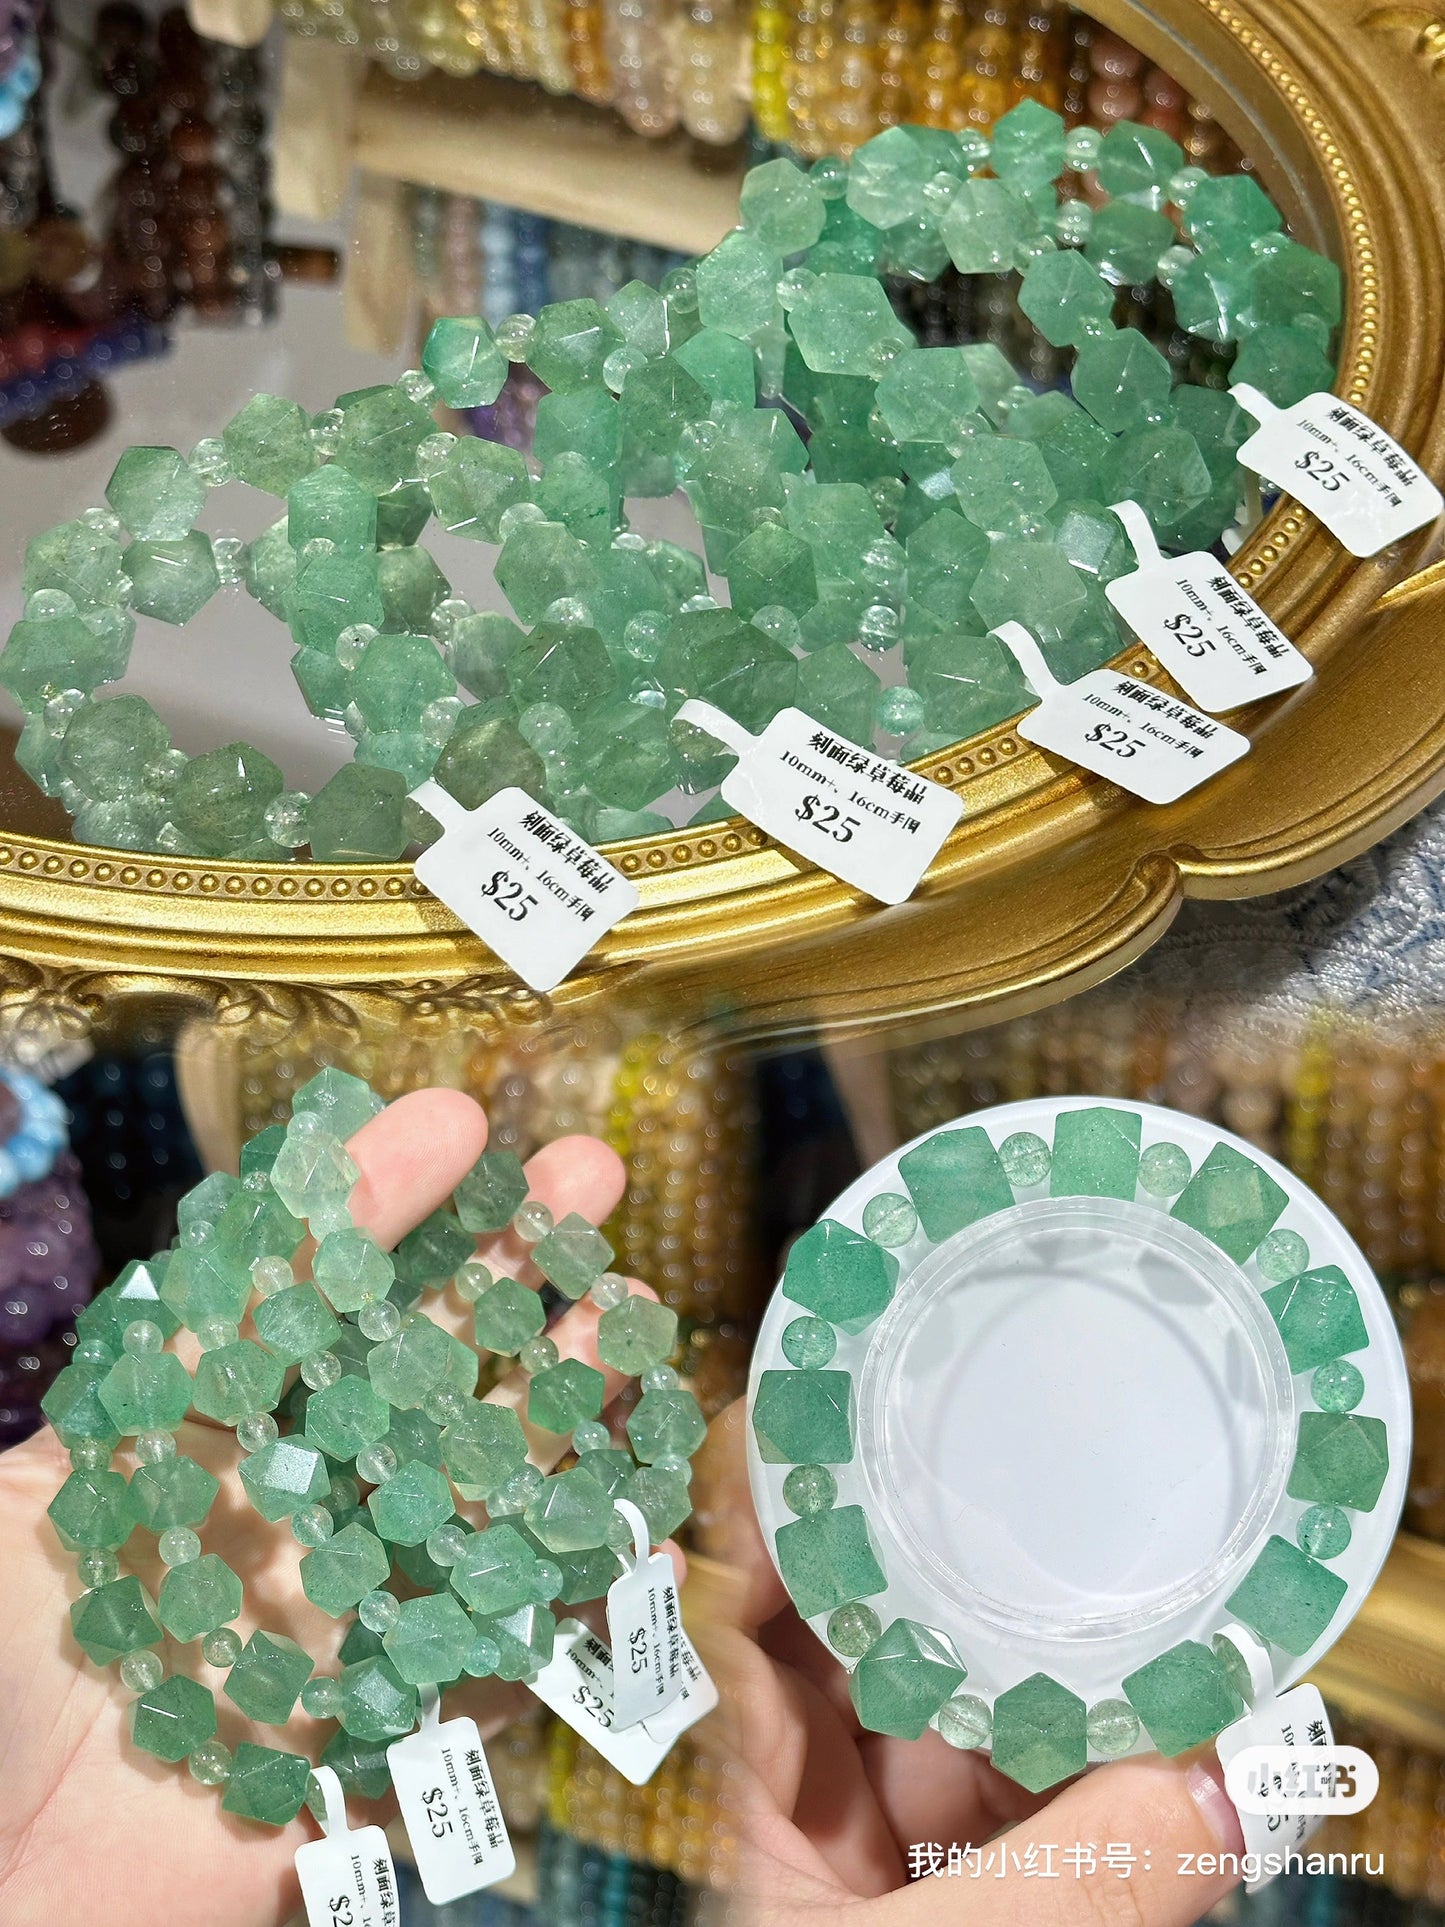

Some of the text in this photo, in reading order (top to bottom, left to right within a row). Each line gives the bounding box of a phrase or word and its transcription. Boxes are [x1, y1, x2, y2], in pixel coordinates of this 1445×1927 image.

[1295, 451, 1350, 492] $25
[1163, 613, 1216, 657] $25
[1084, 722, 1146, 759] $25
[794, 794, 861, 843] $25
[481, 870, 540, 922] $25
[628, 1627, 648, 1675] $25
[572, 1685, 614, 1728] $25
[422, 1787, 454, 1839] $25
